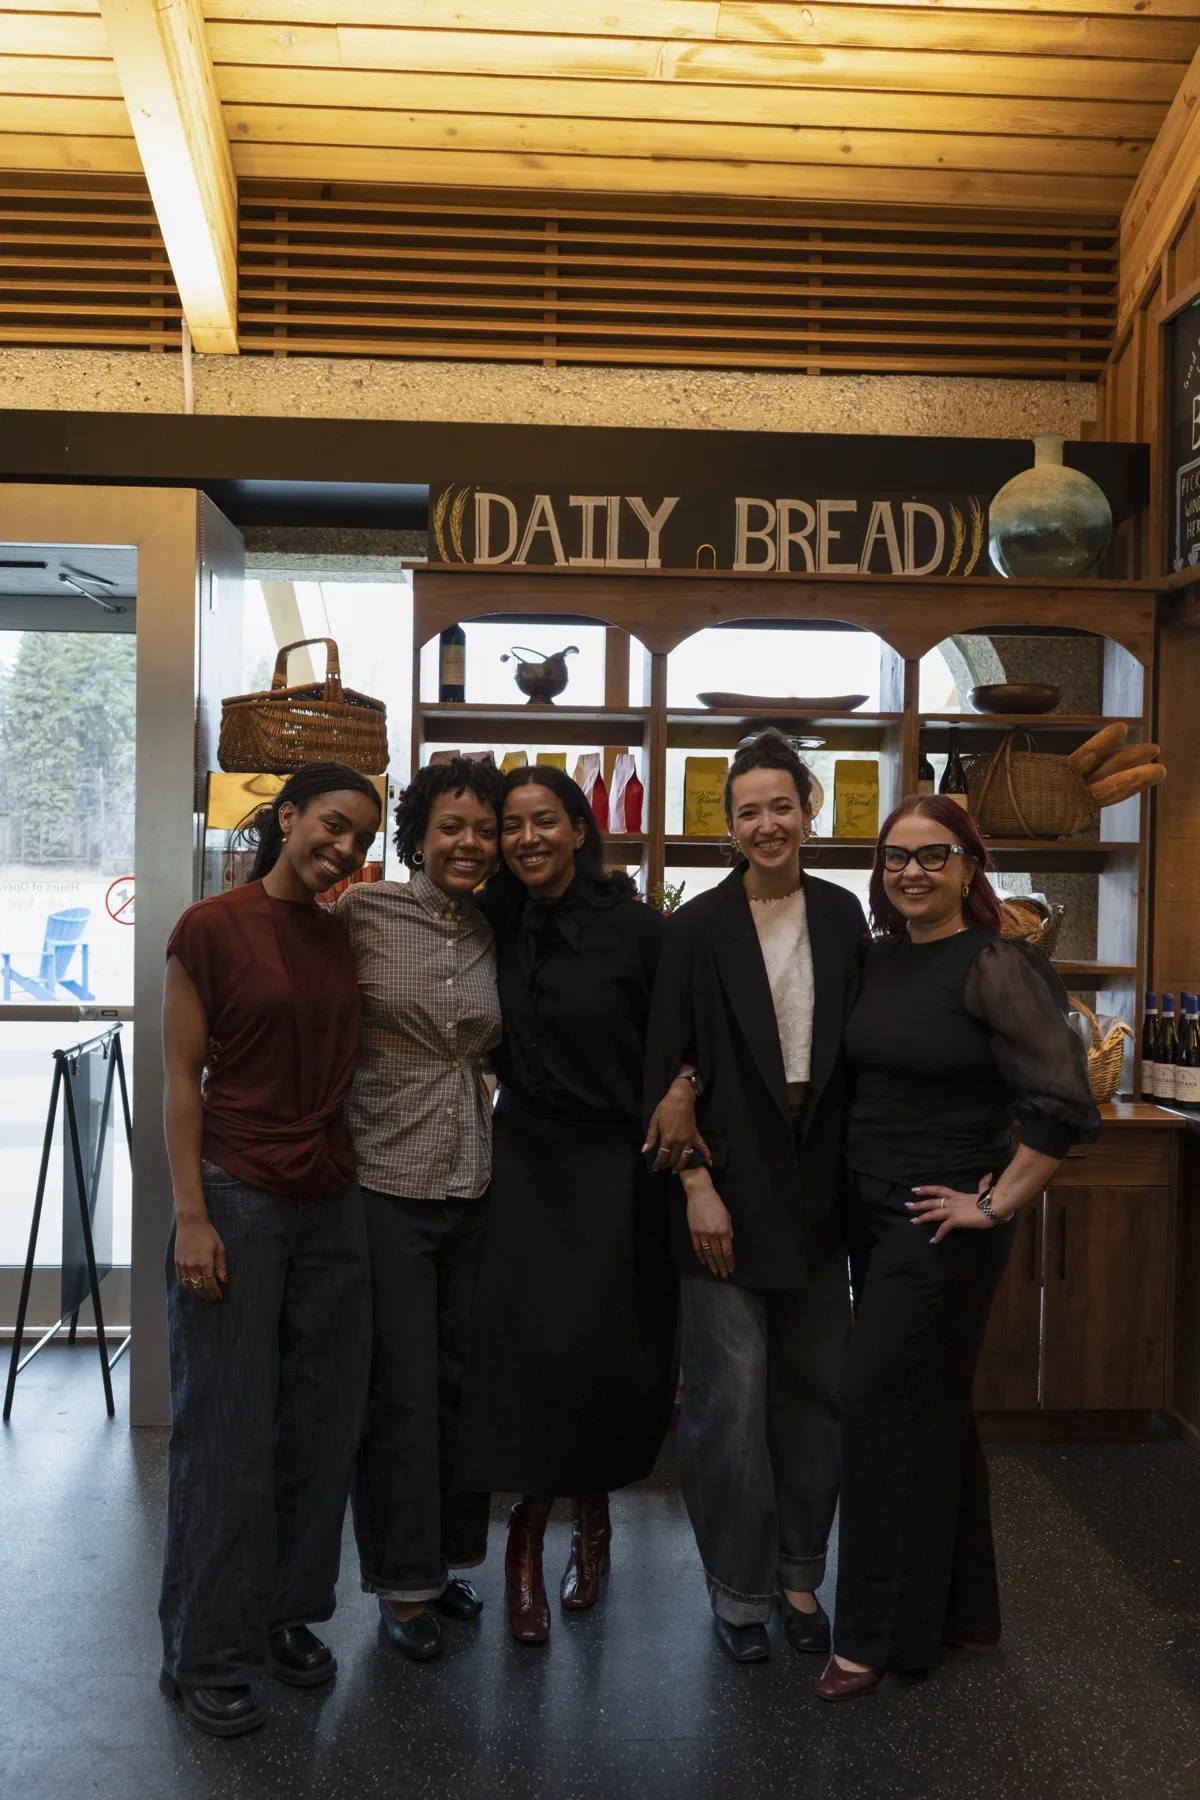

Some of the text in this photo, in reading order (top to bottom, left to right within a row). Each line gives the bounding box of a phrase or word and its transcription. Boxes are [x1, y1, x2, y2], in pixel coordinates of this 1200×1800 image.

[473, 492, 945, 577] DAILY BREAD
[695, 794, 722, 805] Blend
[844, 796, 871, 807] Blend
